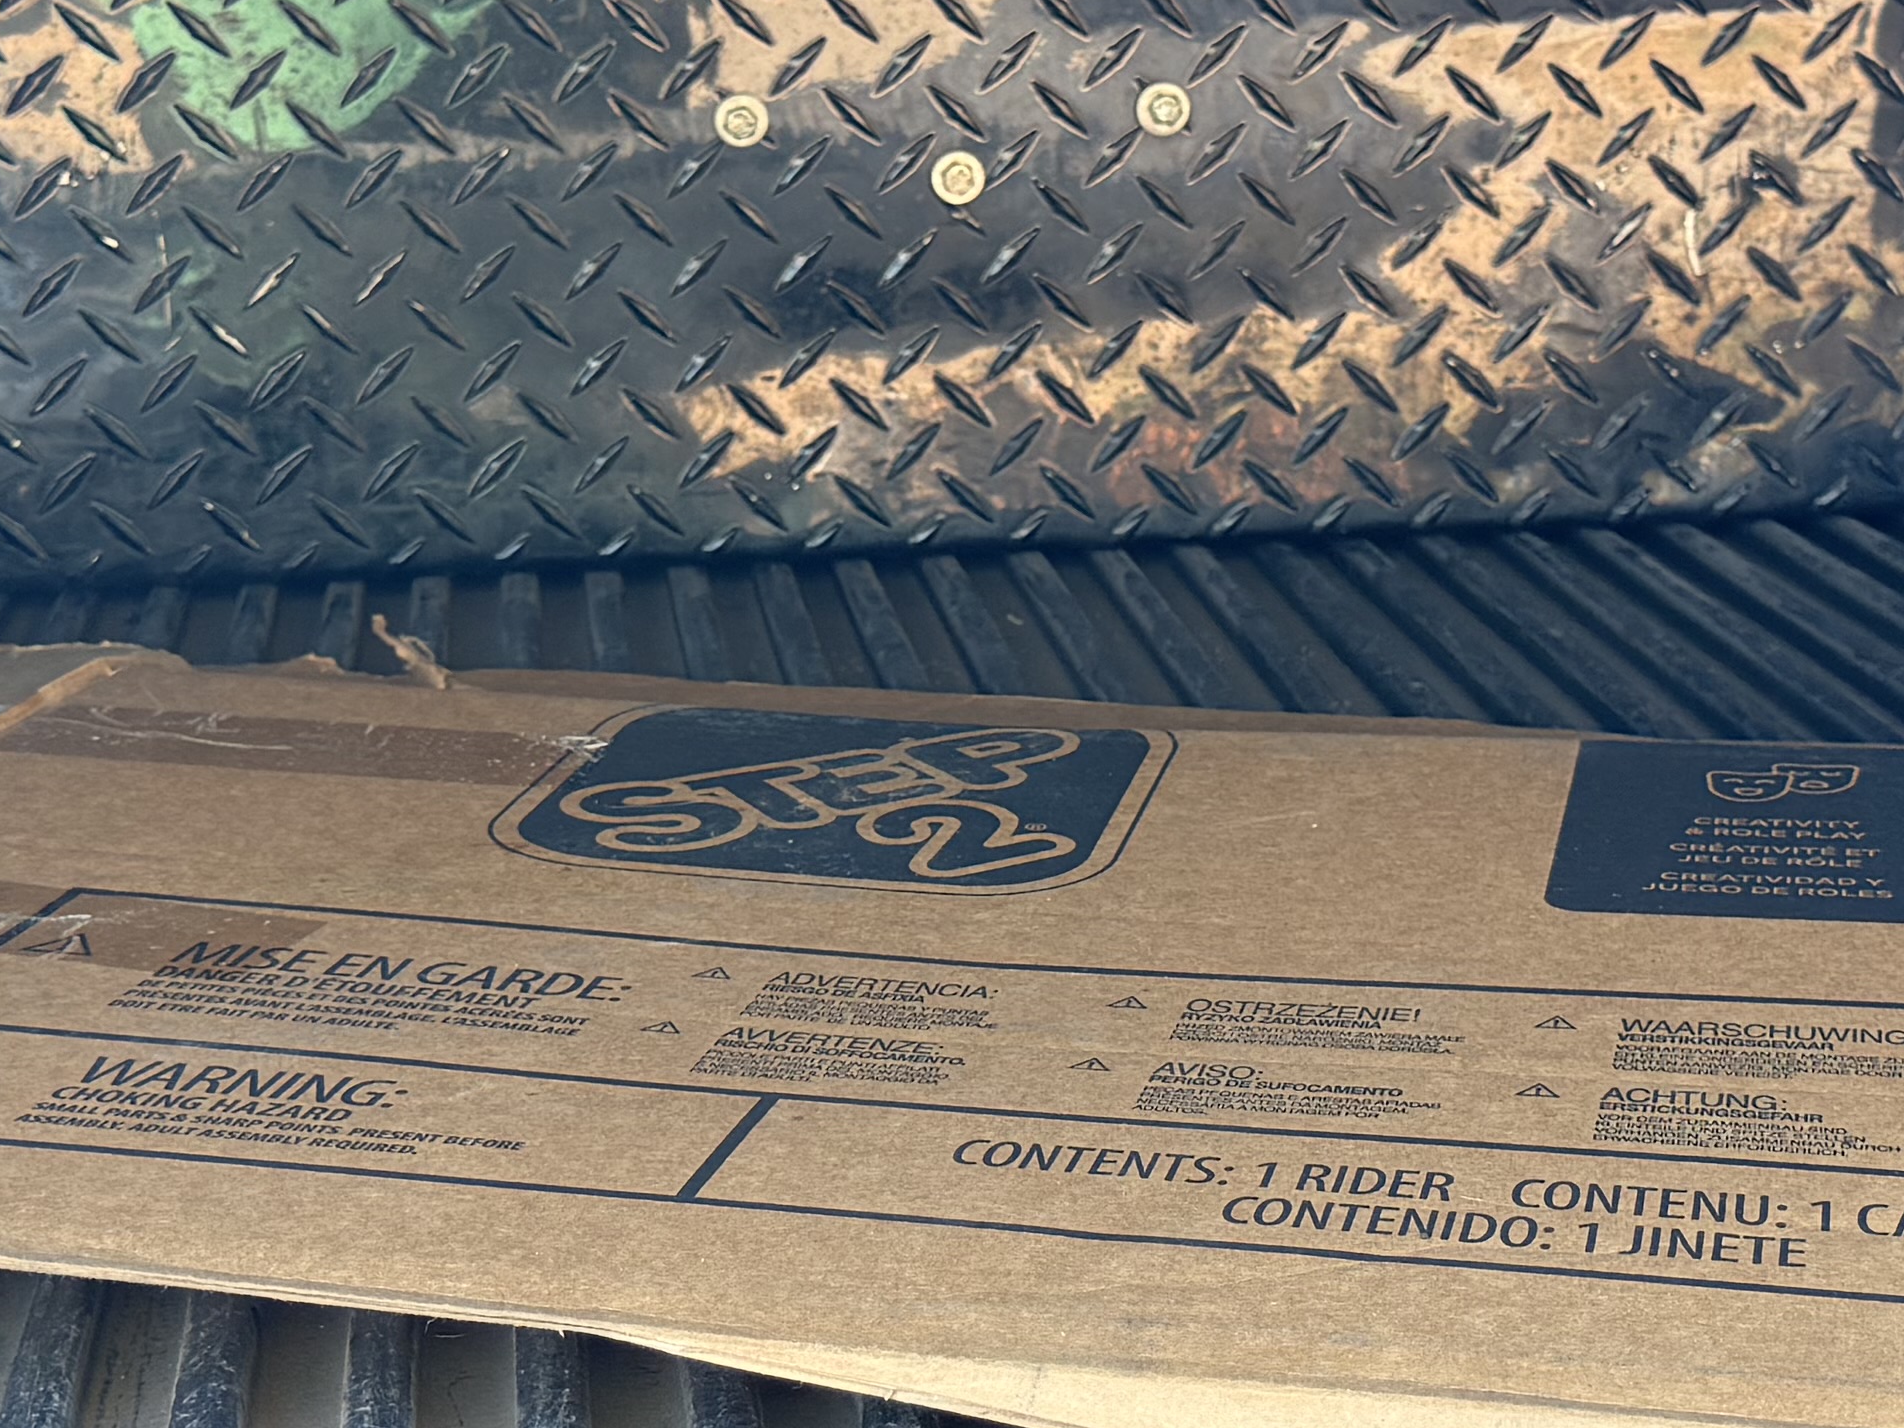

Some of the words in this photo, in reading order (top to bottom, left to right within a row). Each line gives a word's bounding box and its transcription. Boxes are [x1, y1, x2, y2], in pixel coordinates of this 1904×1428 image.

[560, 728, 1081, 853] STEP
[856, 799, 1076, 877] 2
[1694, 817, 1861, 829] CREATIVITY
[1714, 828, 1786, 838] ROLE
[1797, 830, 1866, 840] PLAY
[1678, 855, 1731, 863] JEU
[1742, 856, 1777, 865] DE
[1846, 849, 1880, 857] ET
[1661, 872, 1856, 885] CREATIVIDAD
[1866, 878, 1885, 886] Y
[1642, 884, 1742, 893] JUEGO
[1752, 886, 1788, 895] DE
[1799, 888, 1893, 899] ROLES
[153, 966, 282, 985] DANGER
[170, 941, 328, 973] MISE
[323, 953, 413, 980] EN
[417, 962, 631, 1001] GARDE:
[762, 984, 829, 994] RIESGO
[831, 989, 858, 997] DE
[860, 993, 925, 1003] ASFIXIA
[769, 972, 998, 999] ADVERTENCIA:
[137, 979, 163, 987] DE
[166, 982, 238, 993] PETITES
[332, 996, 370, 1004] DES
[372, 999, 453, 1012] POINTES
[538, 1014, 590, 1025] SONT
[229, 997, 295, 1009] AVANT
[108, 999, 157, 1008] DOIT
[205, 1008, 251, 1016] FAIT
[250, 1012, 289, 1020] PAR
[292, 1015, 321, 1023] UN
[324, 1018, 399, 1030] ADULTE.
[1180, 1012, 1254, 1023] RYZYKO
[714, 1039, 788, 1051] RISCHIO
[813, 1048, 966, 1065] SOFFOCAMENTO.
[722, 1027, 943, 1055] AVVERTENZE:
[1619, 1033, 1834, 1051] VERSTIKKINGSGEVAAR
[81, 1057, 408, 1108] WARNING:
[1153, 1062, 1263, 1080] AVISO:
[1149, 1075, 1221, 1086] PERIGO
[1225, 1080, 1251, 1088] DE
[1256, 1081, 1403, 1097] SUFOCAMENTO
[52, 1087, 208, 1110] CHOKING
[208, 1099, 353, 1121] HAZARD
[1600, 1087, 1787, 1111] ACHTUNG:
[1599, 1102, 1823, 1123] ERSTICKUNGSGEFAHR
[33, 1102, 99, 1115] SMALL
[103, 1108, 172, 1120] PARTS
[190, 1116, 265, 1127] SHARP
[265, 1121, 342, 1134] POINTS
[348, 1128, 444, 1143] PRESENT
[443, 1136, 526, 1150] BEFORE
[129, 1123, 199, 1135] ADULT
[197, 1129, 306, 1144] ASSEMBLY
[308, 1138, 417, 1154] REQUIRED.
[952, 1140, 1234, 1185] CONTENTS:
[1257, 1162, 1278, 1187] 1
[1296, 1164, 1454, 1201] RIDER
[1512, 1179, 1788, 1228] CONTENU:
[1811, 1201, 1833, 1231] 1
[1222, 1196, 1555, 1250] CONTENIDO:
[1580, 1223, 1598, 1252] 1
[1618, 1226, 1806, 1267] JINETE
